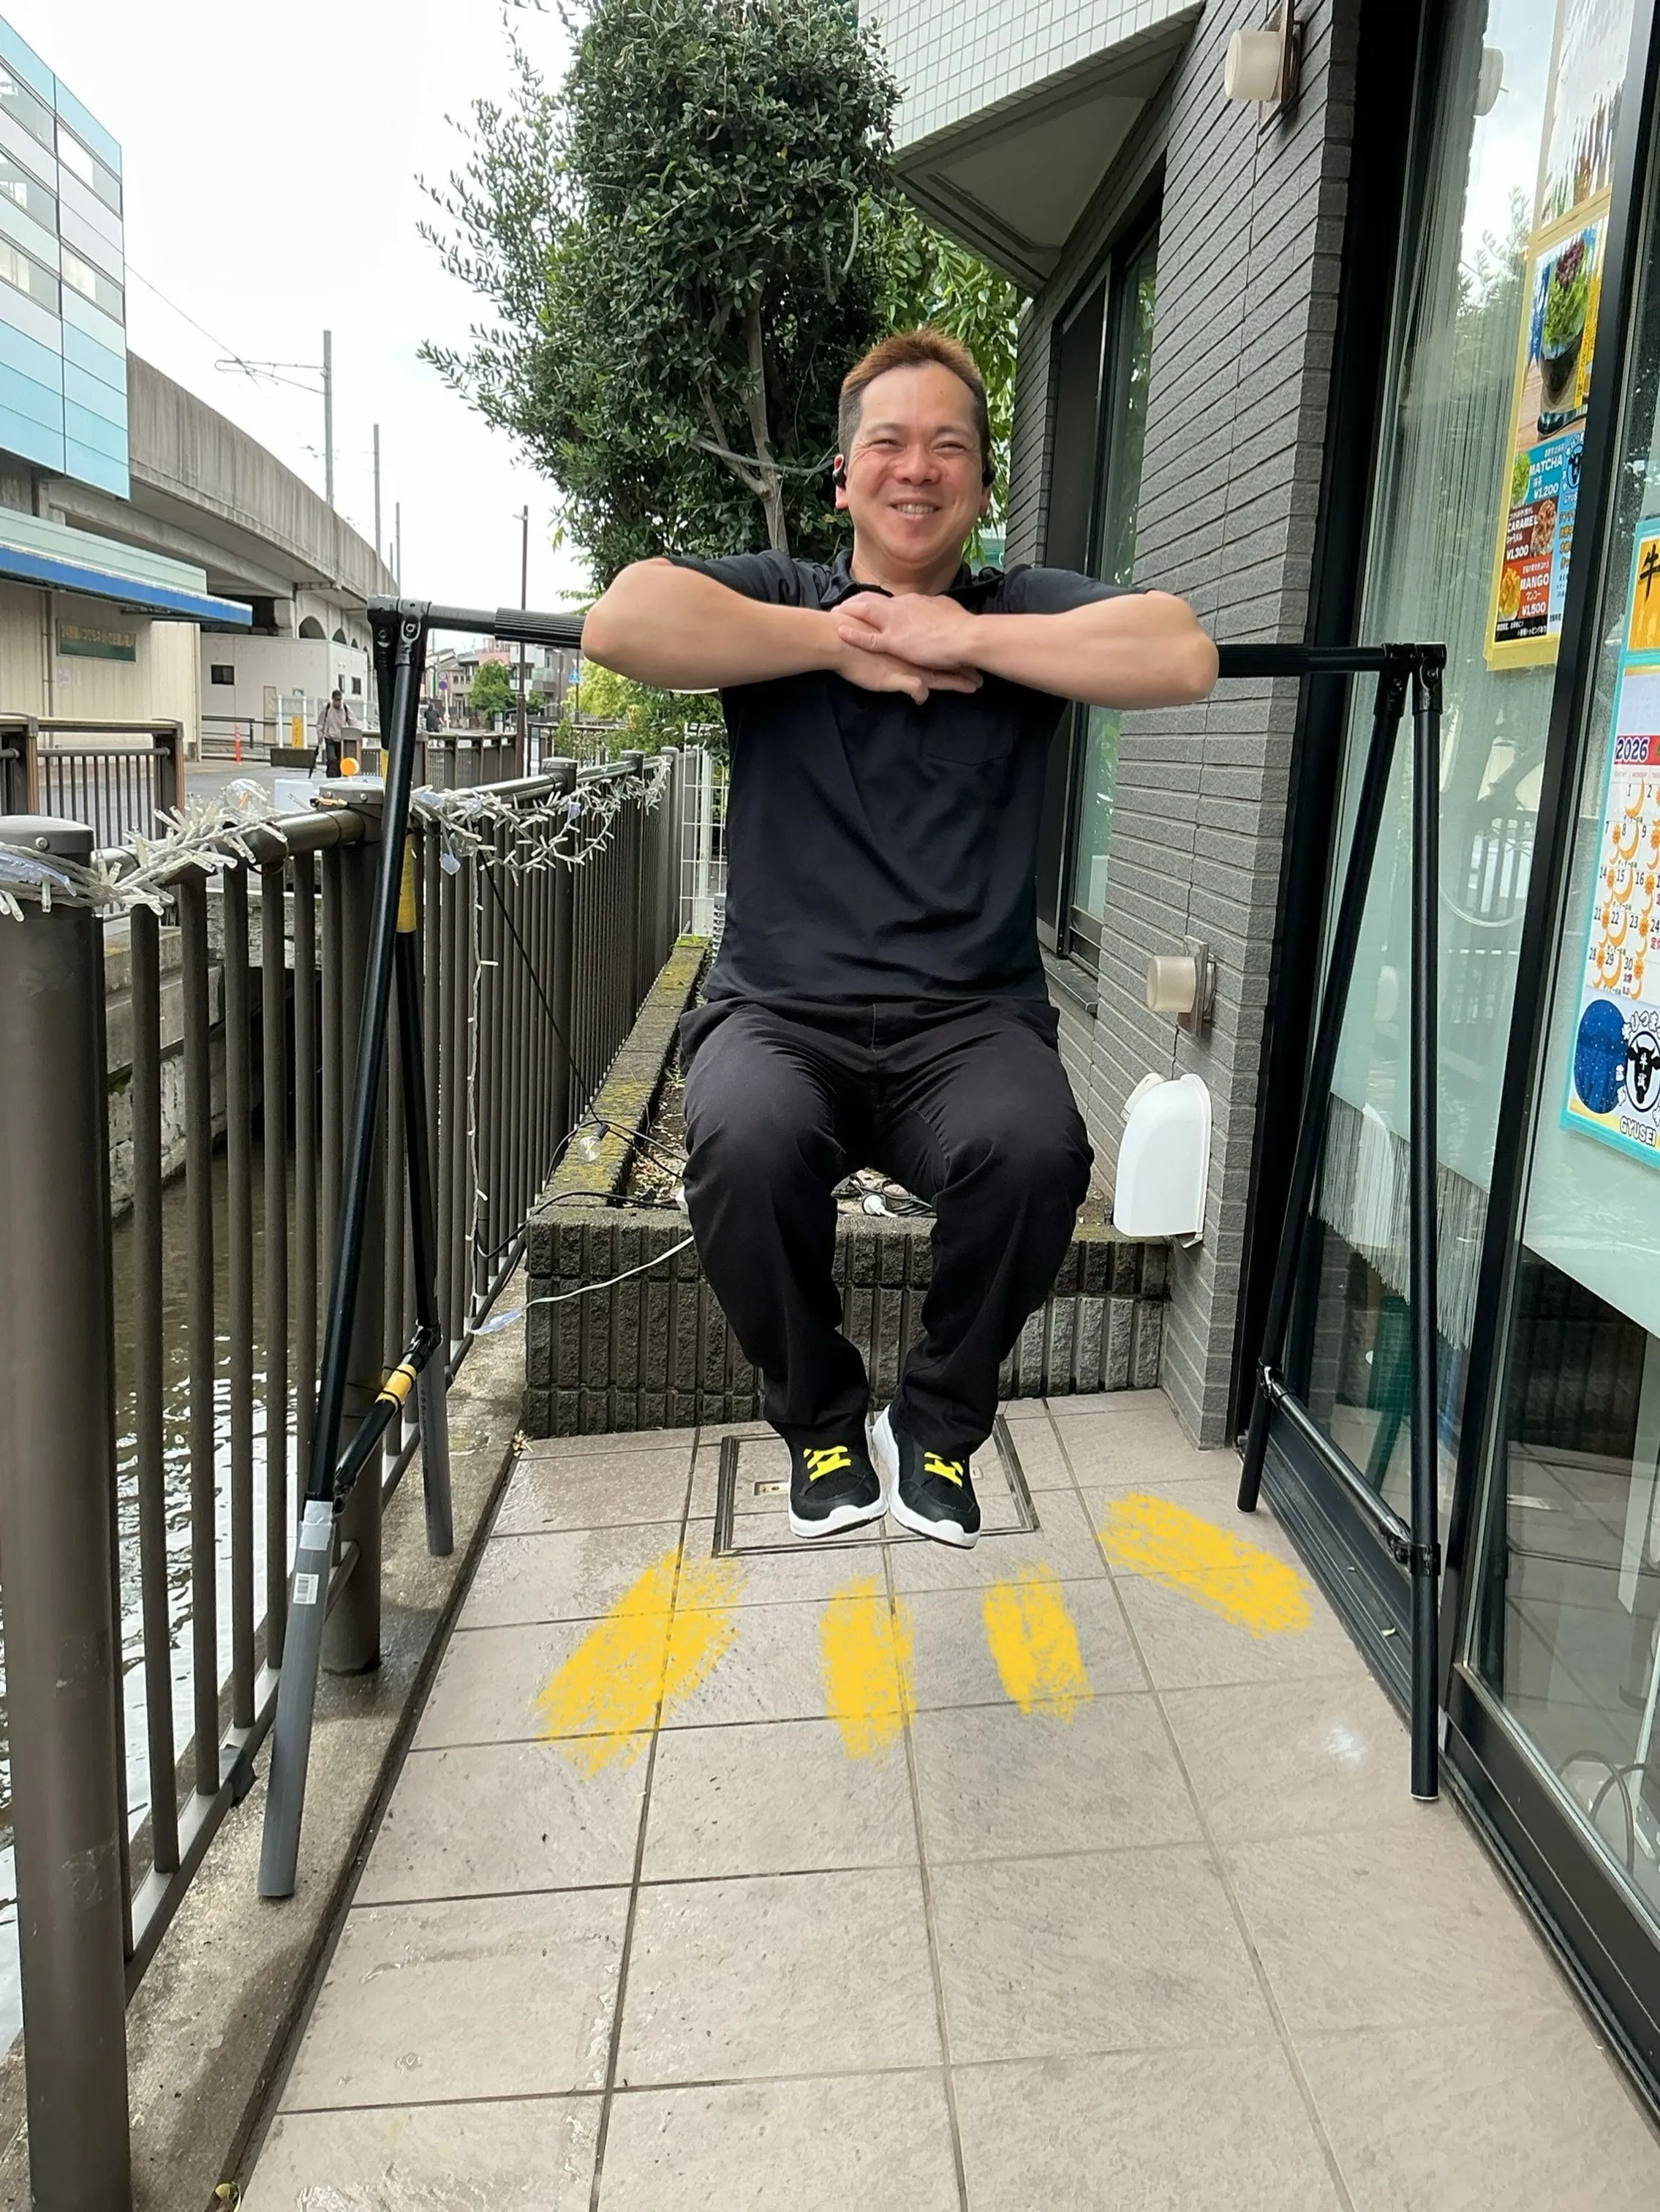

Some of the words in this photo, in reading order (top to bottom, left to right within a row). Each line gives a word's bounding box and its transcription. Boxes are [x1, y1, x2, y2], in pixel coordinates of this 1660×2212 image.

[1529, 454, 1562, 476] MATCHA
[1508, 514, 1539, 533] CARAMEL
[1520, 573, 1549, 590] MANGO
[1613, 737, 1650, 763] 2026
[1628, 784, 1631, 797] 1
[1647, 784, 1652, 798] 2
[1605, 821, 1609, 834] 7
[1622, 823, 1626, 836] 8
[1641, 824, 1647, 838] 9
[1599, 866, 1607, 879] 14
[1617, 869, 1625, 882] 15
[1635, 872, 1645, 885] 16
[1594, 907, 1601, 920] 21
[1611, 911, 1619, 925] 22
[1629, 915, 1638, 929] 23
[1650, 919, 1660, 933] 24
[1589, 947, 1596, 960] 28
[1605, 952, 1614, 966] 29
[1623, 957, 1633, 971] 30
[1620, 1116, 1656, 1147] GYUSEI
